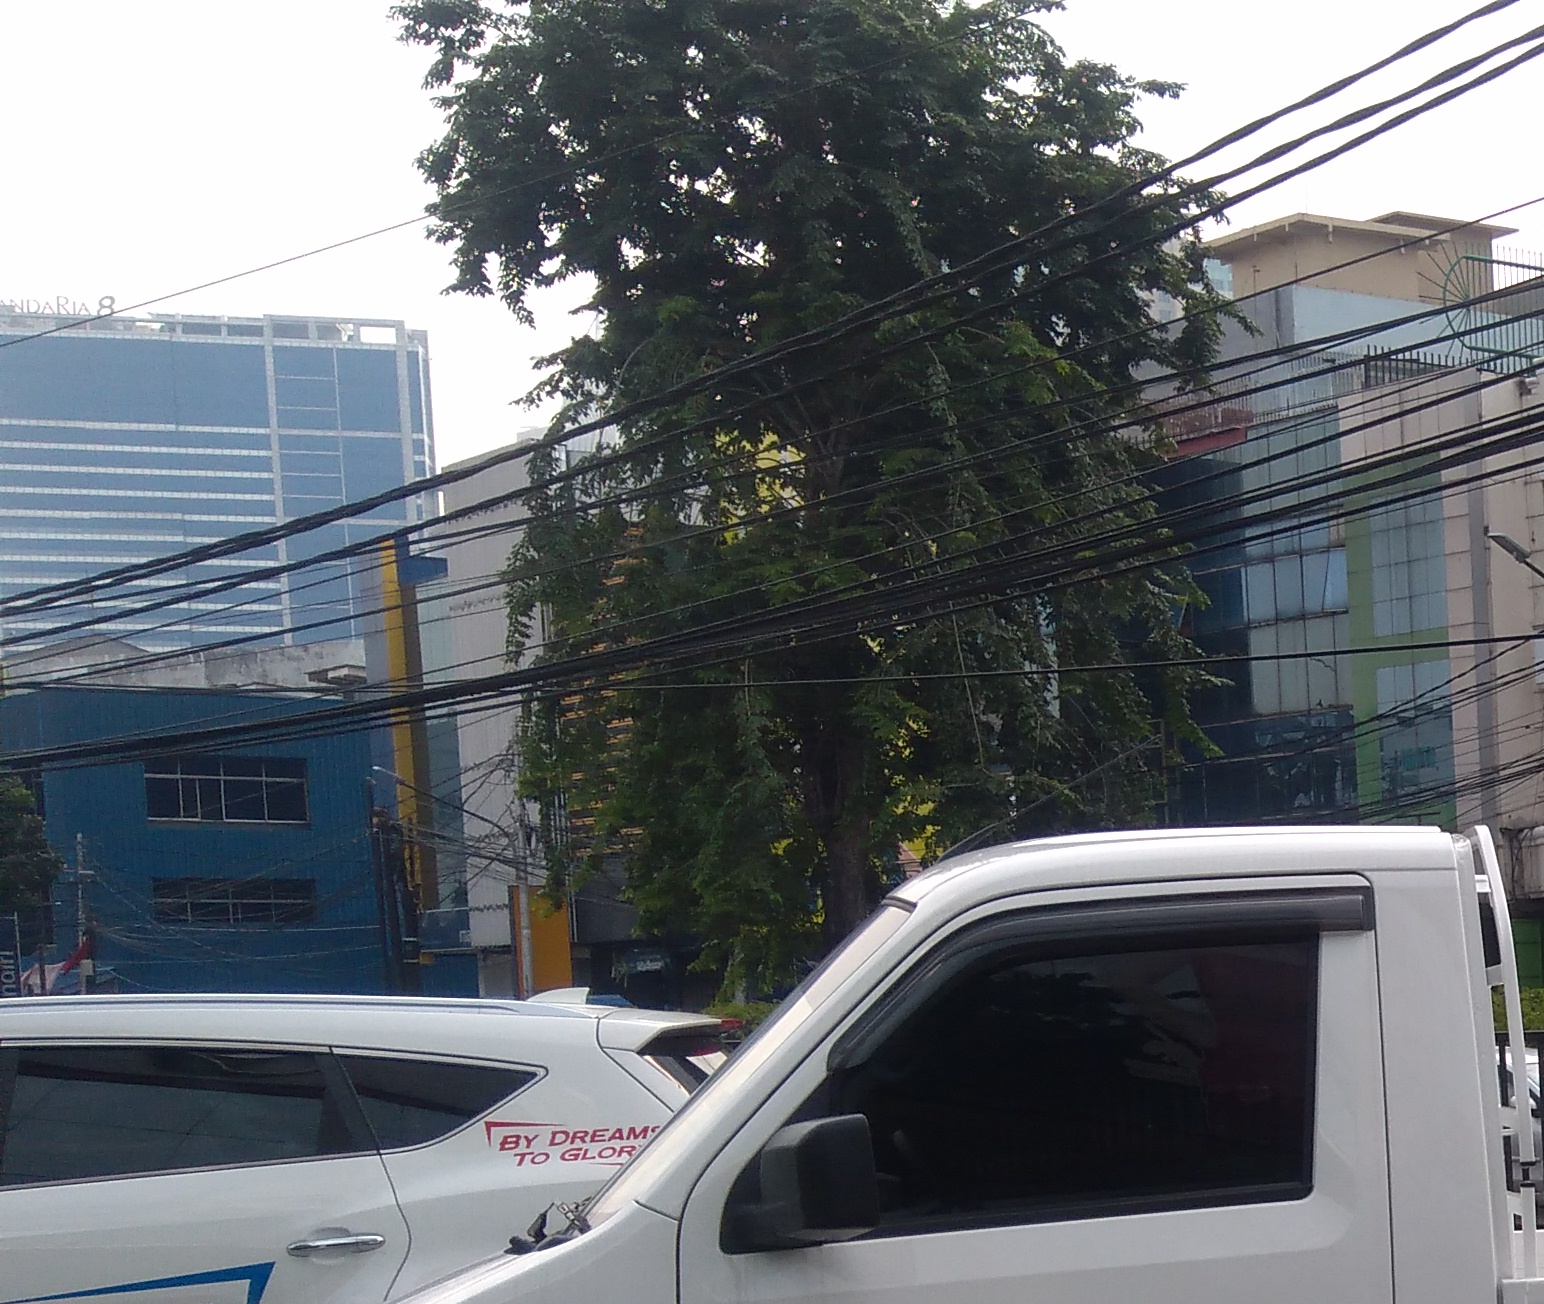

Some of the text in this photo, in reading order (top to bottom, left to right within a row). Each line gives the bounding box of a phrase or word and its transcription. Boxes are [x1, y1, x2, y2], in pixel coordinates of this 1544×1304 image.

[97, 295, 115, 315] 8
[499, 1134, 539, 1151] BY
[514, 1144, 642, 1167] TO GLOR
